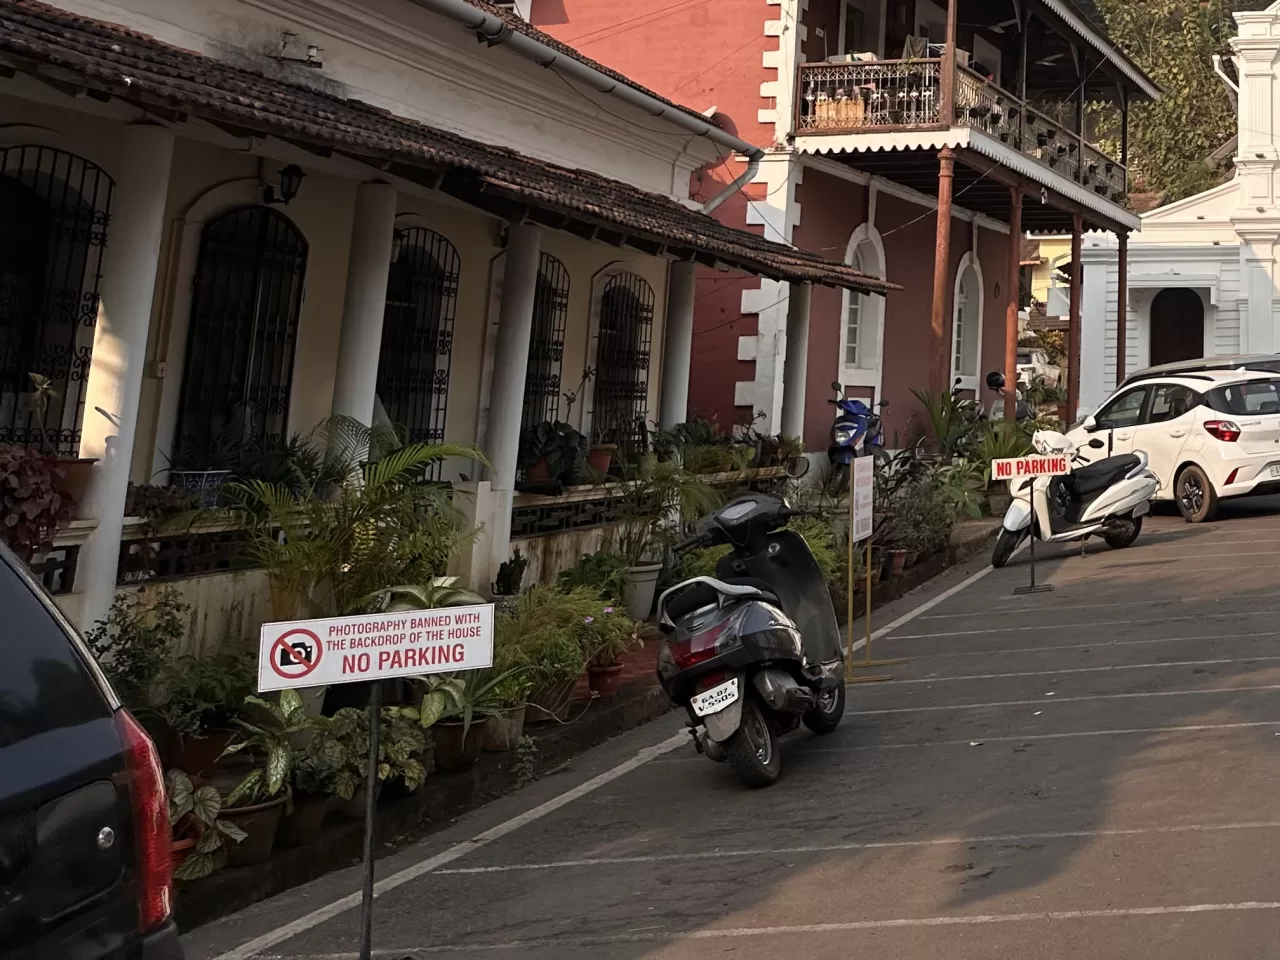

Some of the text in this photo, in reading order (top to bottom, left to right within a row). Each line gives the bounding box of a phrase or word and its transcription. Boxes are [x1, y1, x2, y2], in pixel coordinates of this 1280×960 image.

[996, 458, 1066, 476] NO PARKING
[328, 613, 480, 637] PHOTOGRAPHY BANNED WITH
[326, 626, 482, 651] THE BACKDROP OF THE HOUSE
[342, 643, 465, 674] NO PARKING
